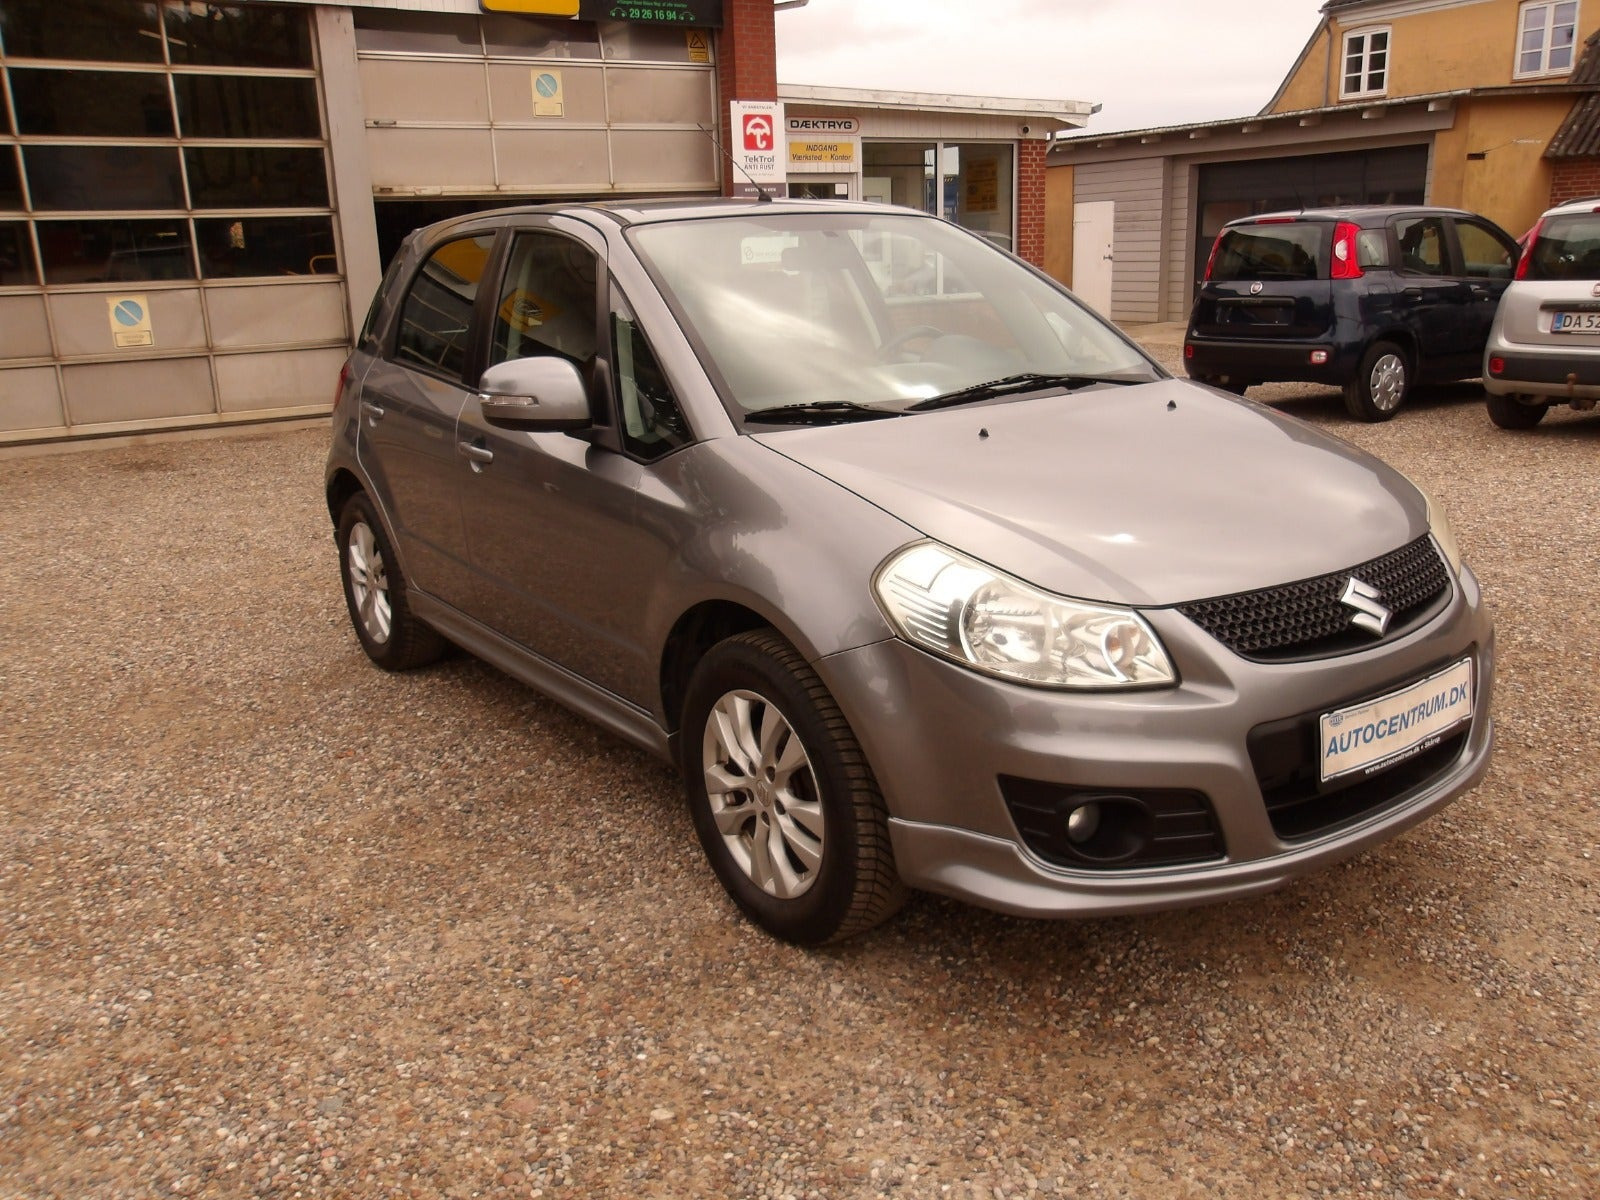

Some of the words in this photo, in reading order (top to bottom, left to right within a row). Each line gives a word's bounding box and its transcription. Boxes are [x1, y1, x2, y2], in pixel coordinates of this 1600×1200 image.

[629, 8, 640, 18] 29
[642, 9, 652, 19] 26
[655, 10, 664, 20] 16
[666, 11, 676, 20] 94
[790, 119, 852, 130] DÆKTRYG
[805, 144, 838, 152] INDGANG
[744, 155, 775, 163] TekTrol
[792, 153, 823, 161] Værksted
[830, 153, 851, 161] Kontor
[1563, 315, 1581, 328] DA
[1326, 681, 1468, 758] AUTOCENTRUM.DK
